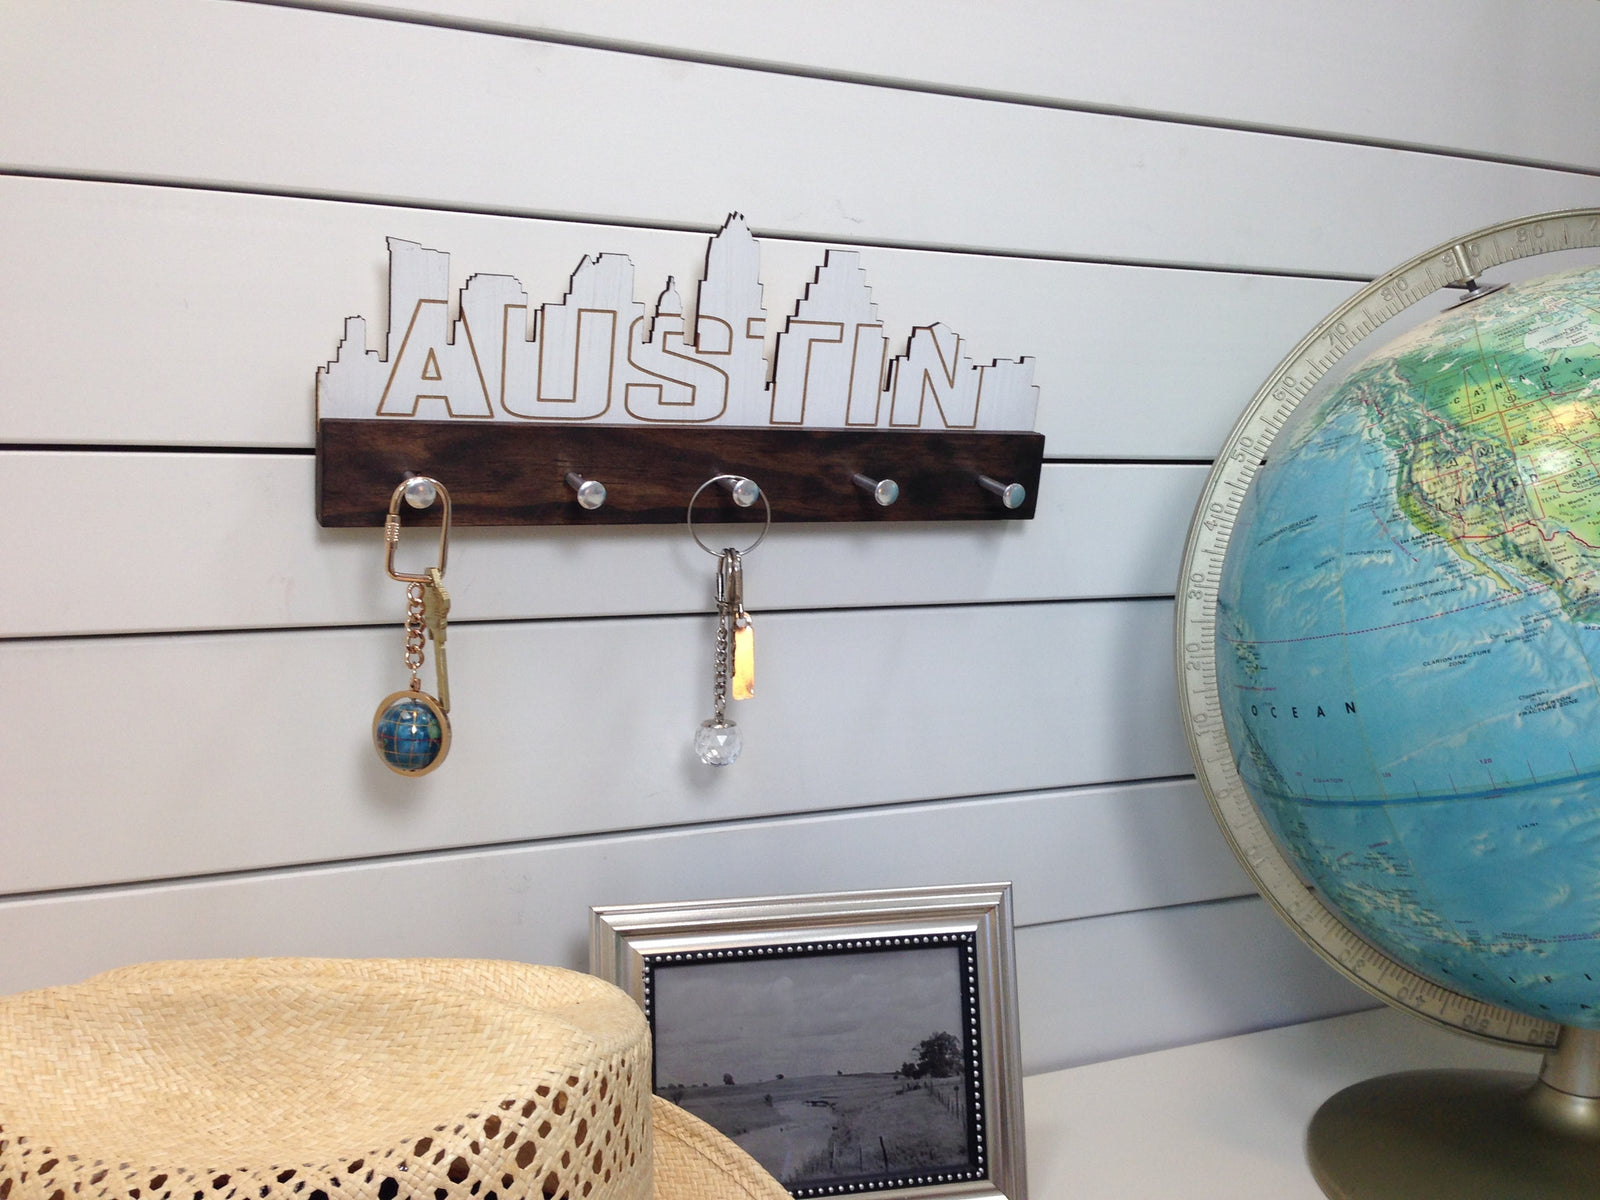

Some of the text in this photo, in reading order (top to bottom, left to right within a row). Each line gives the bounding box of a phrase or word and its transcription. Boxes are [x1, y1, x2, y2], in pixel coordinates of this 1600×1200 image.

[1379, 277, 1408, 302] 80
[1322, 320, 1348, 346] 70
[377, 298, 984, 429] AUSTIN
[1271, 375, 1297, 402] 60
[1230, 436, 1253, 464] 50
[1203, 502, 1225, 531] 40
[1188, 573, 1206, 601] 30
[1185, 642, 1202, 672] 20
[1422, 648, 1492, 667] CLARION FRACTURE
[1448, 659, 1468, 668] ZONE
[1250, 701, 1357, 719] OCEAN
